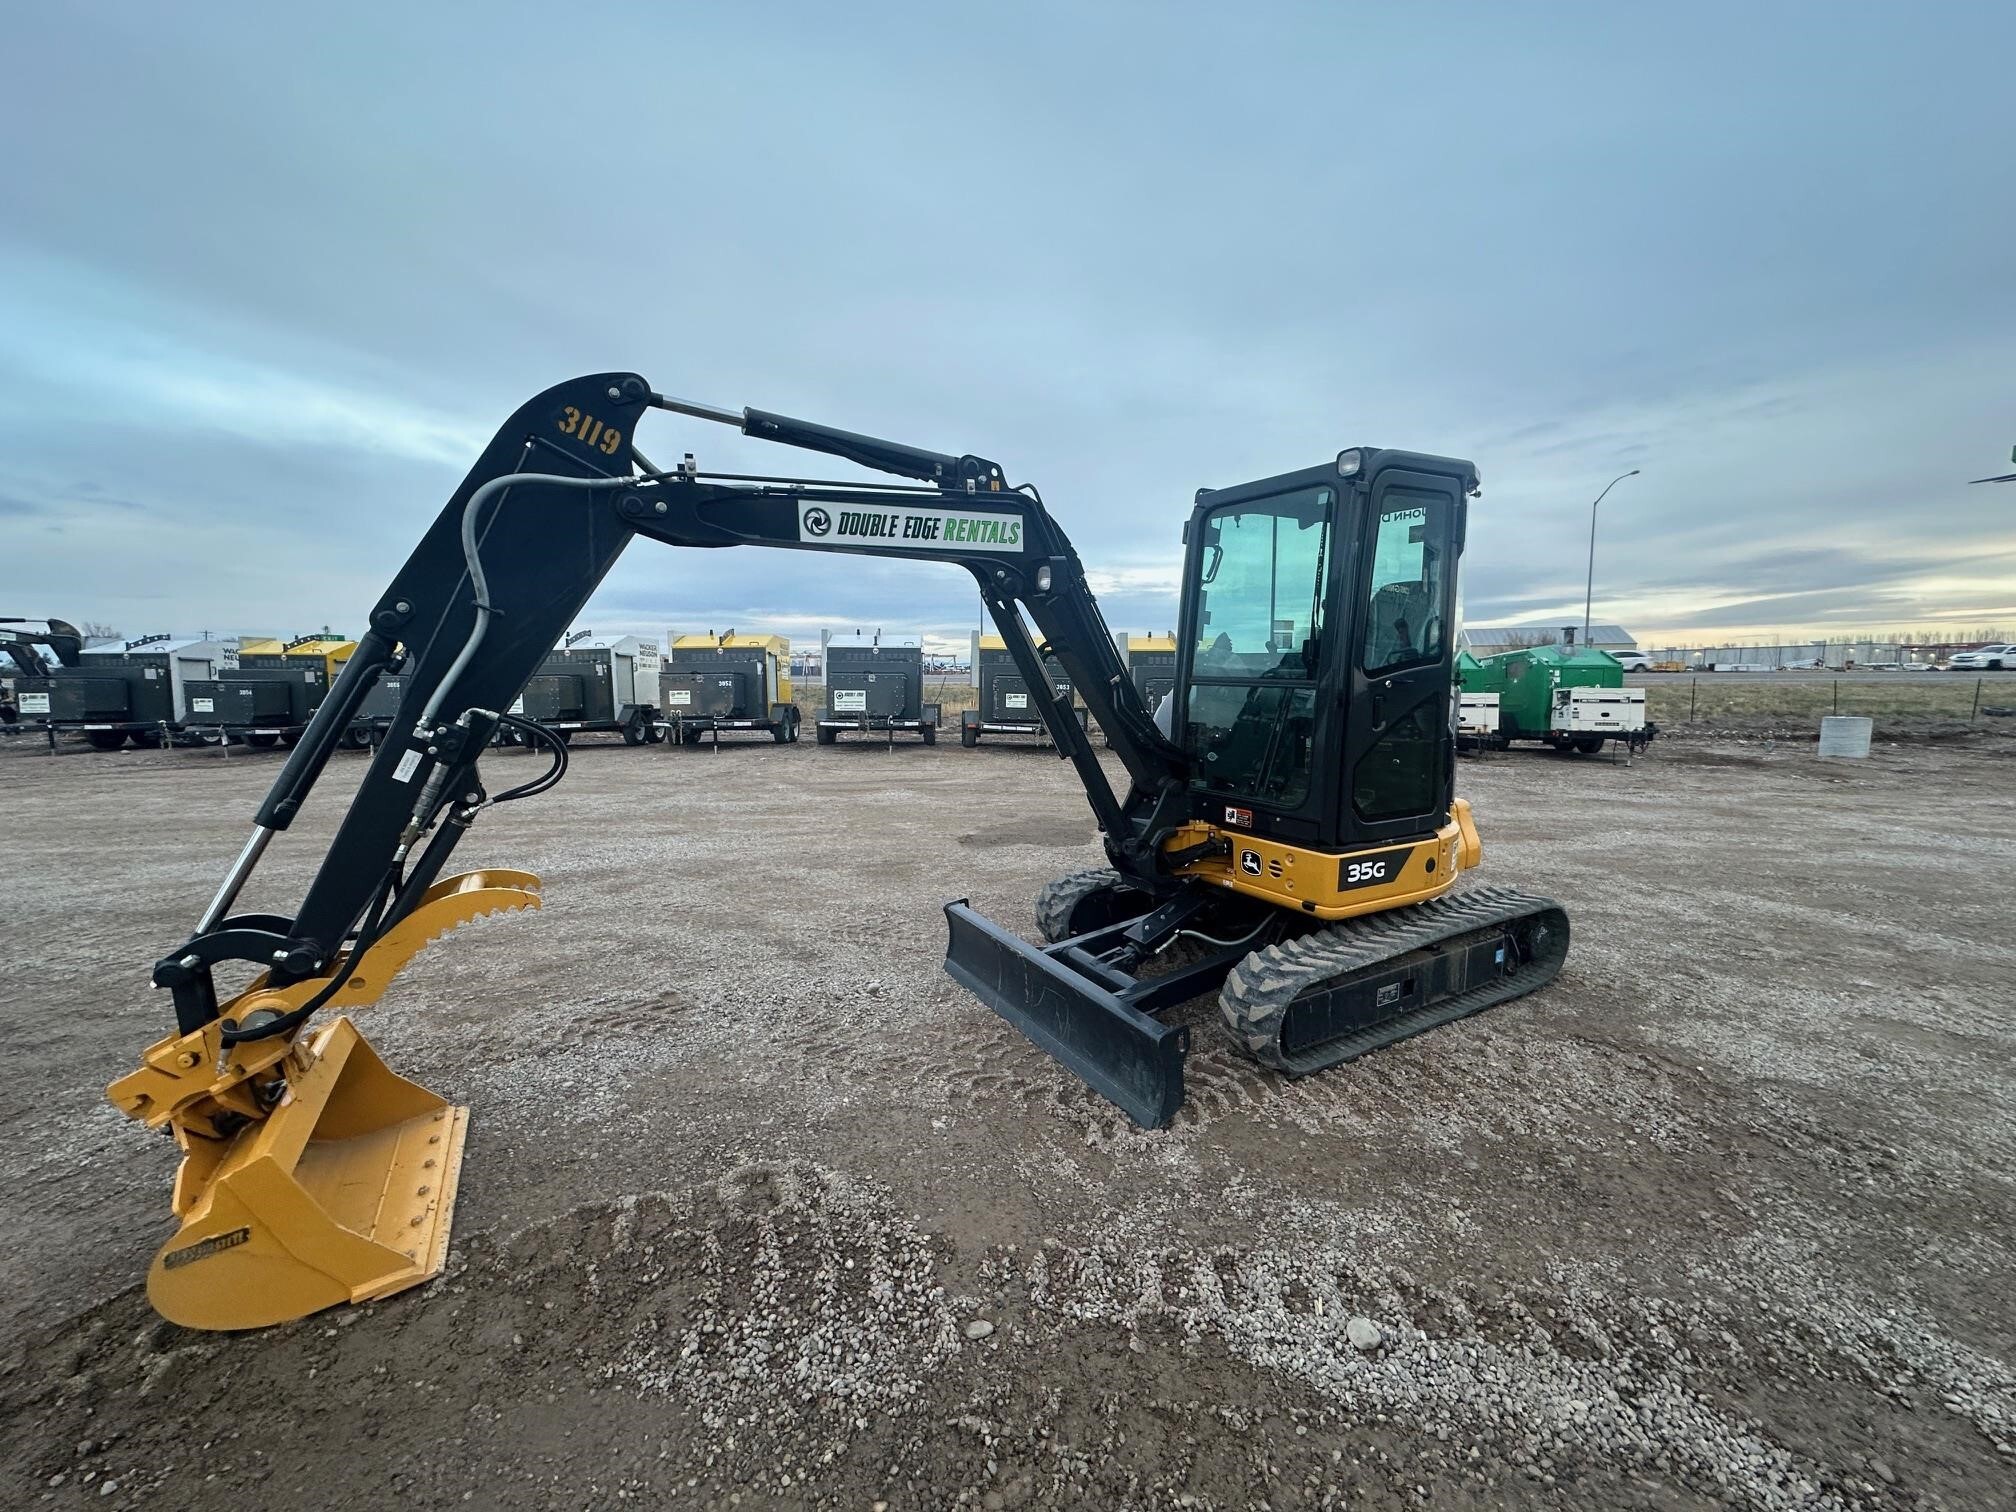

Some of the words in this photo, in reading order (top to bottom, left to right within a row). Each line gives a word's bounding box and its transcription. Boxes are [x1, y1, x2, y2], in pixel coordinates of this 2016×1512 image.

[558, 406, 621, 455] 3119
[837, 511, 900, 538] DOUBLE
[902, 515, 941, 541] EDGE
[943, 517, 1021, 545] RENTALS
[1347, 861, 1386, 883] 35G
